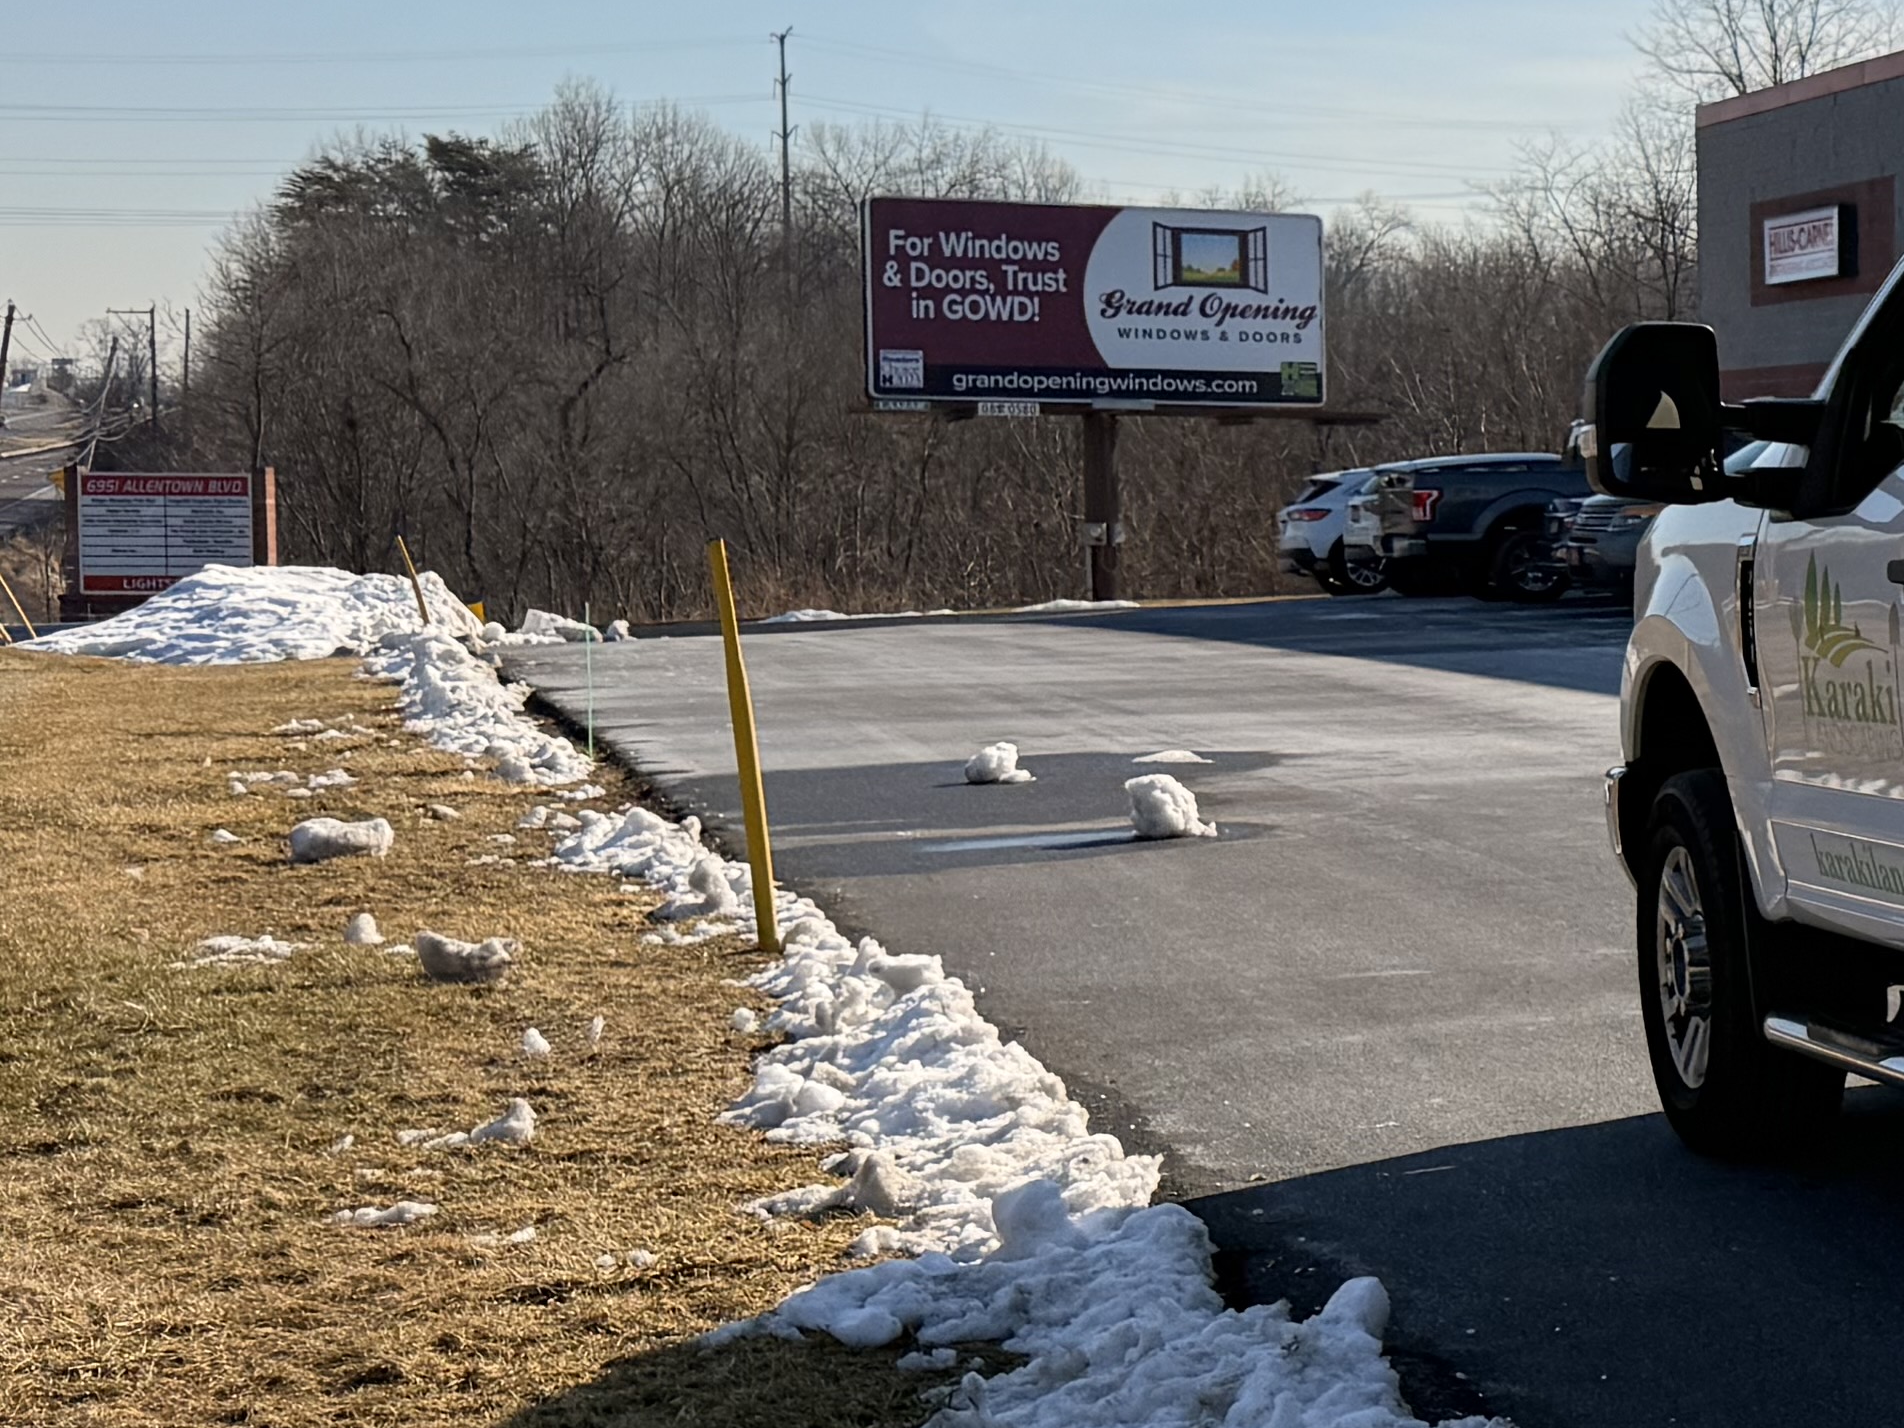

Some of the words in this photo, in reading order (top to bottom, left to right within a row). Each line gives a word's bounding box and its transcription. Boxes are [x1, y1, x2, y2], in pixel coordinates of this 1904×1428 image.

[889, 229, 933, 257] For
[939, 231, 1060, 262] Windows
[883, 260, 902, 287] &
[910, 262, 995, 294] Doors,
[1001, 264, 1068, 292] Trust
[911, 291, 935, 319] in
[942, 294, 1040, 322] GOWD!
[1099, 289, 1194, 319] Grand
[1199, 292, 1318, 330] Opening
[1118, 327, 1210, 341] WINDOWS
[1219, 329, 1229, 341] &
[1239, 330, 1303, 344] DOORS
[952, 371, 1258, 394] grandopeningwindows.com
[86, 479, 119, 493] 6951
[122, 479, 203, 493] ALLENTOWN
[1801, 656, 1897, 726] Karaki
